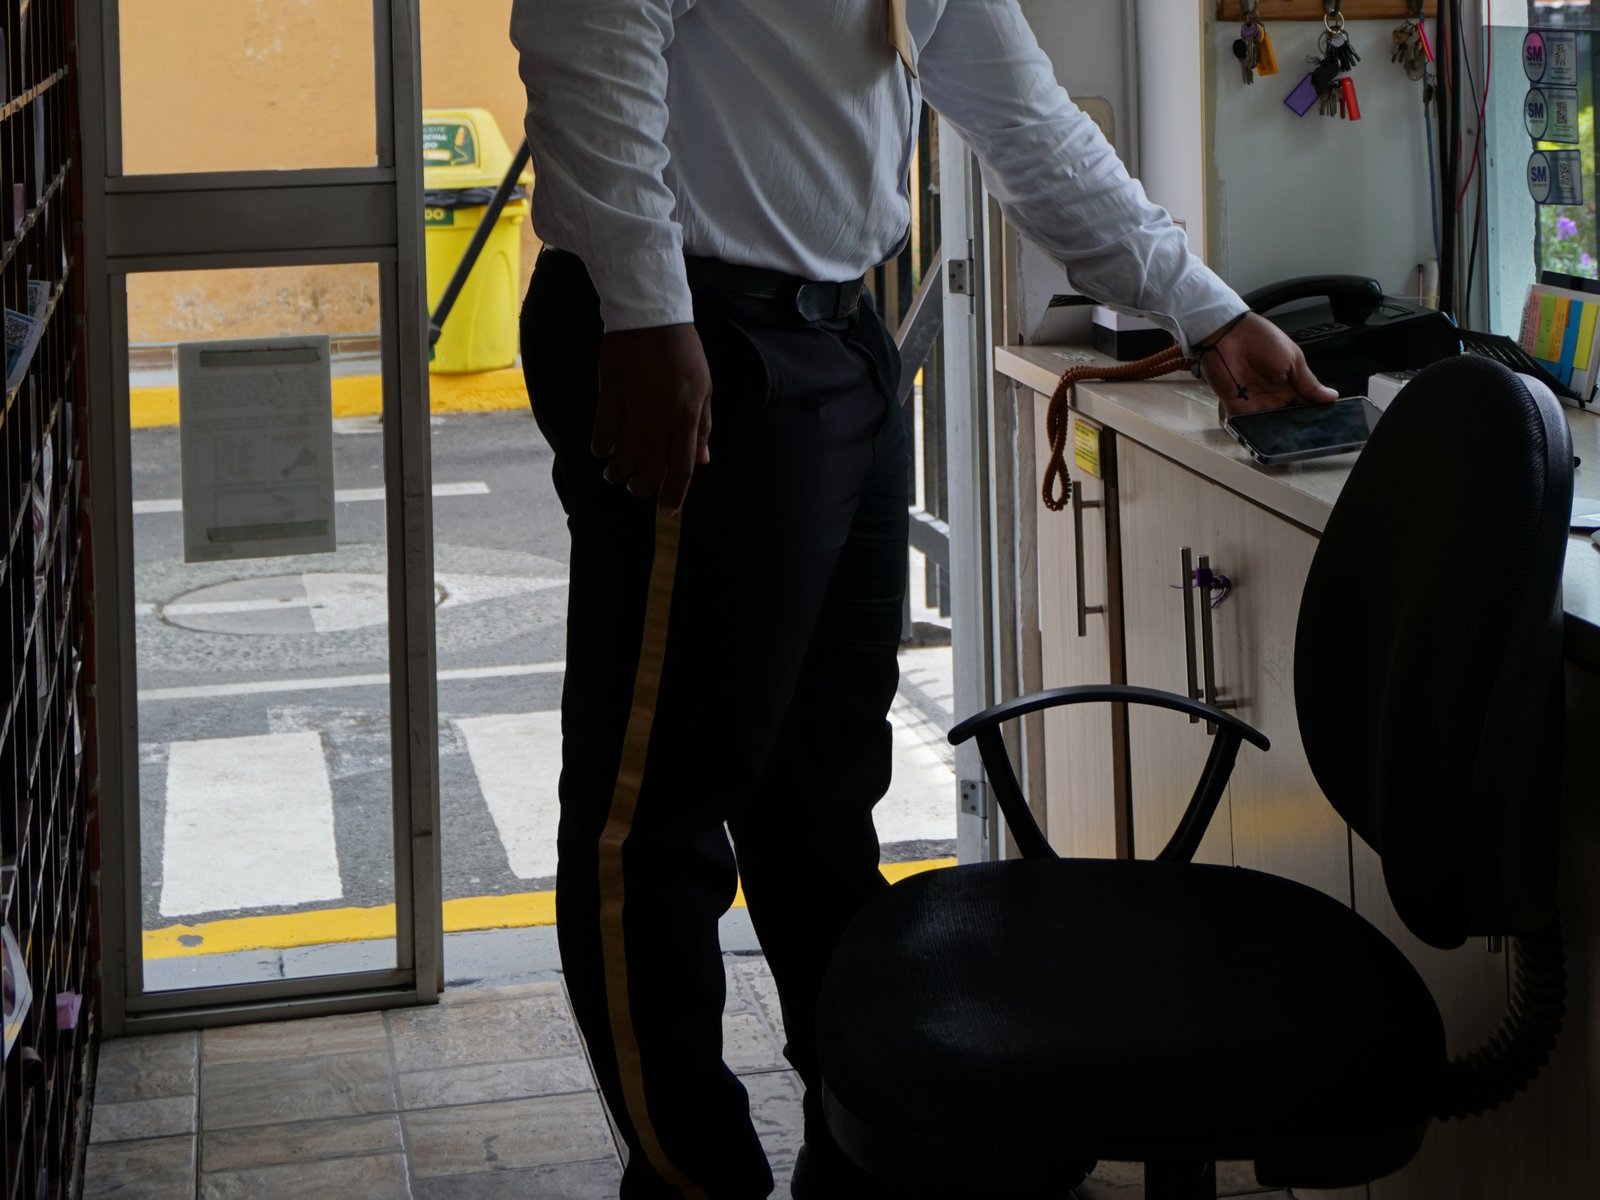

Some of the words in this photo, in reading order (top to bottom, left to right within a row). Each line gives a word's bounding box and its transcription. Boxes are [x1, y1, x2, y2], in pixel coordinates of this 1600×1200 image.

[1526, 46, 1542, 62] SM
[1528, 102, 1544, 119] SM
[423, 126, 445, 134] CEITE
[1531, 166, 1547, 182] SM
